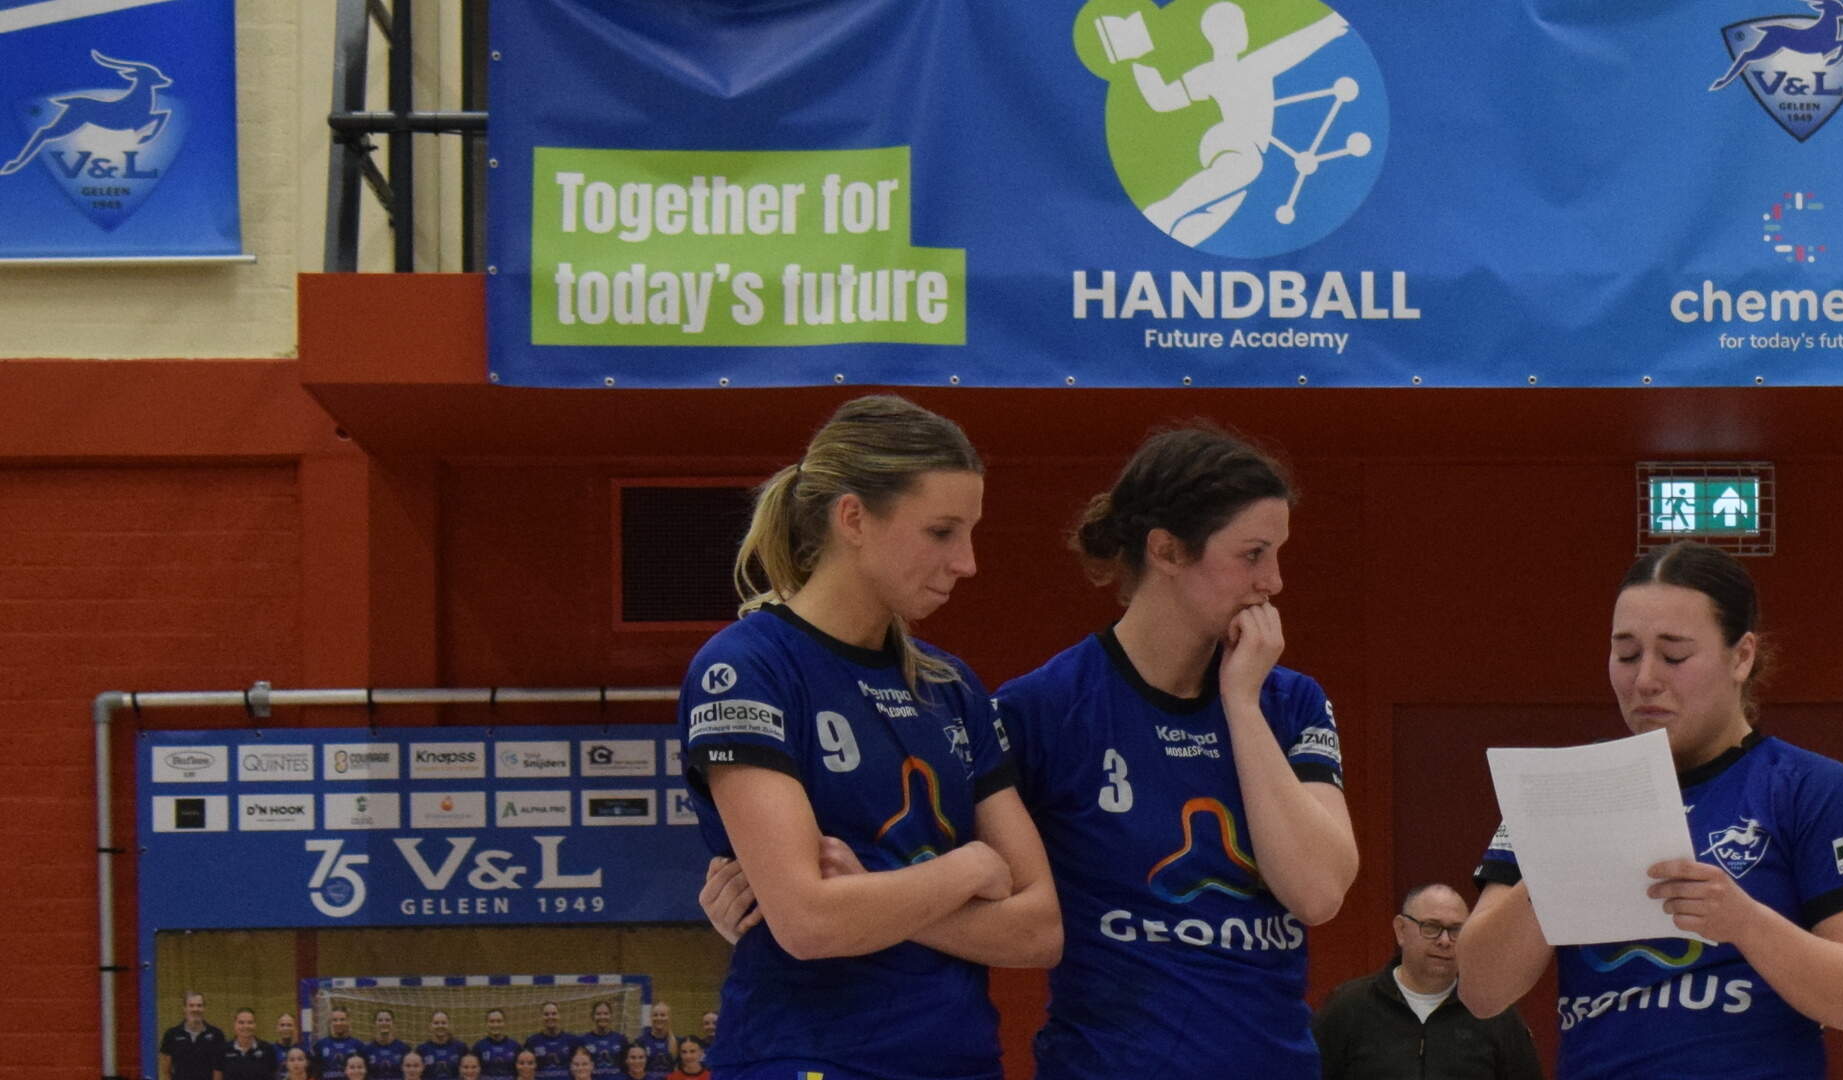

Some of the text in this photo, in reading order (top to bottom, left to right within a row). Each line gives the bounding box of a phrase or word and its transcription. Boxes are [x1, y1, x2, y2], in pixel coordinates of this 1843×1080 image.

[1752, 71, 1843, 96] V&L
[1779, 102, 1820, 111] GELEEN
[50, 151, 158, 179] V&L
[81, 187, 130, 196] GELEEN
[555, 172, 899, 243] Together for
[555, 263, 948, 333] today's future
[1073, 270, 1421, 319] HANDBALL
[1145, 329, 1349, 354] Future Academy
[1719, 333, 1744, 348] for
[1750, 333, 1814, 352] today's
[816, 711, 861, 772] 9
[244, 754, 309, 772] QUINTES
[1098, 748, 1133, 813] 3
[270, 806, 305, 815] HOOK
[393, 836, 602, 890] V&L
[1717, 847, 1758, 861] V&L
[401, 896, 605, 915] GELEEN 1949
